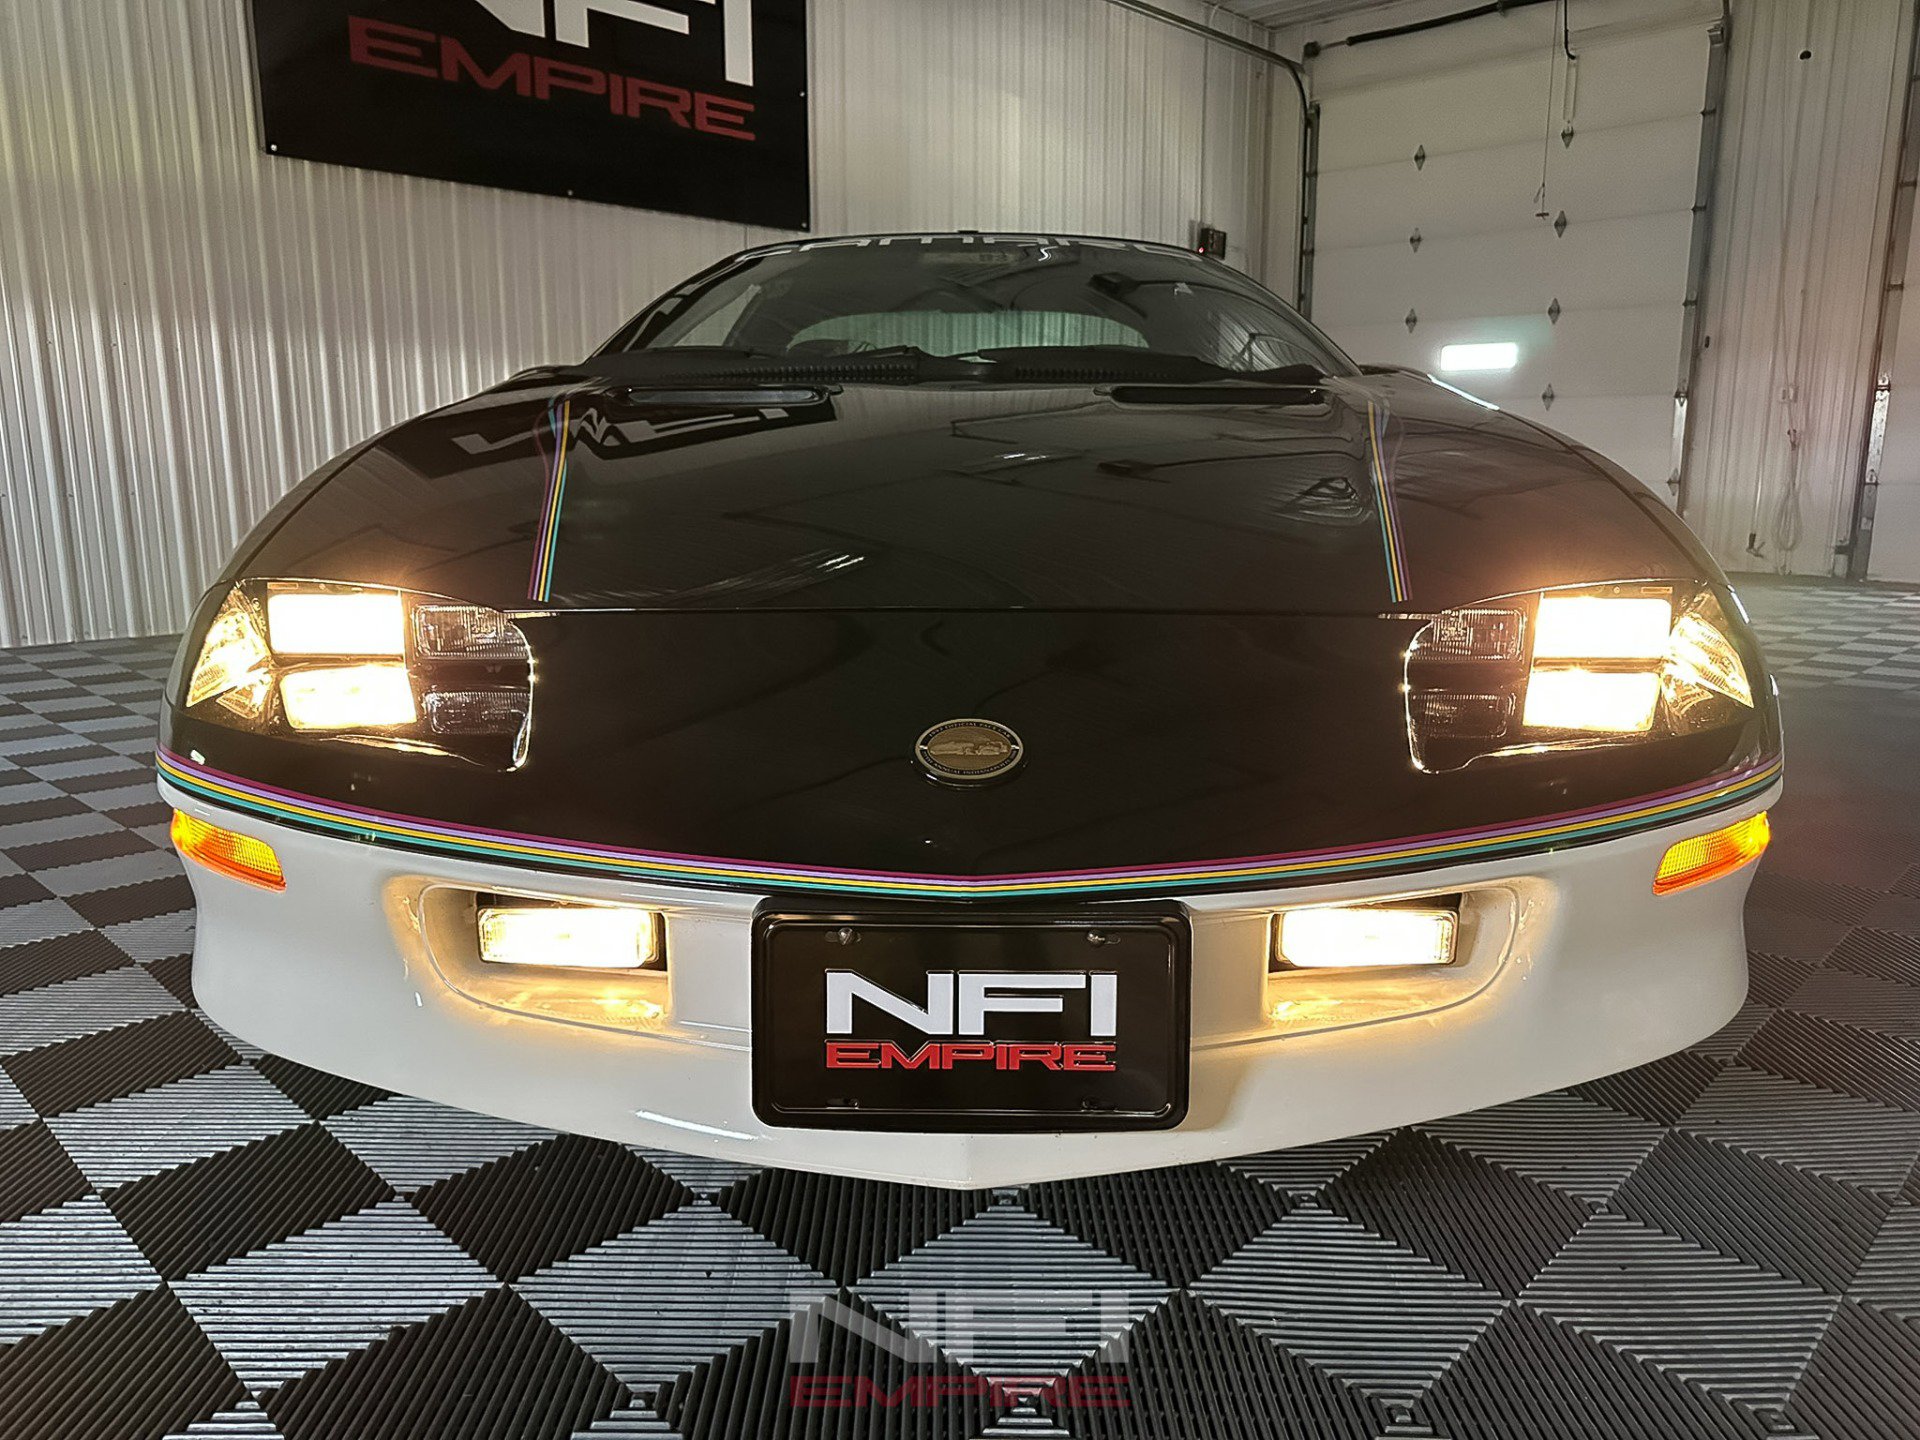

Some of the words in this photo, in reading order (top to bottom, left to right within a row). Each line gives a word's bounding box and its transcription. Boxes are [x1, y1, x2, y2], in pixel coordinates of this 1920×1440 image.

[348, 15, 756, 141] EMPIRE
[825, 969, 1117, 1036] NFI
[825, 1039, 1117, 1072] EMPIRE
